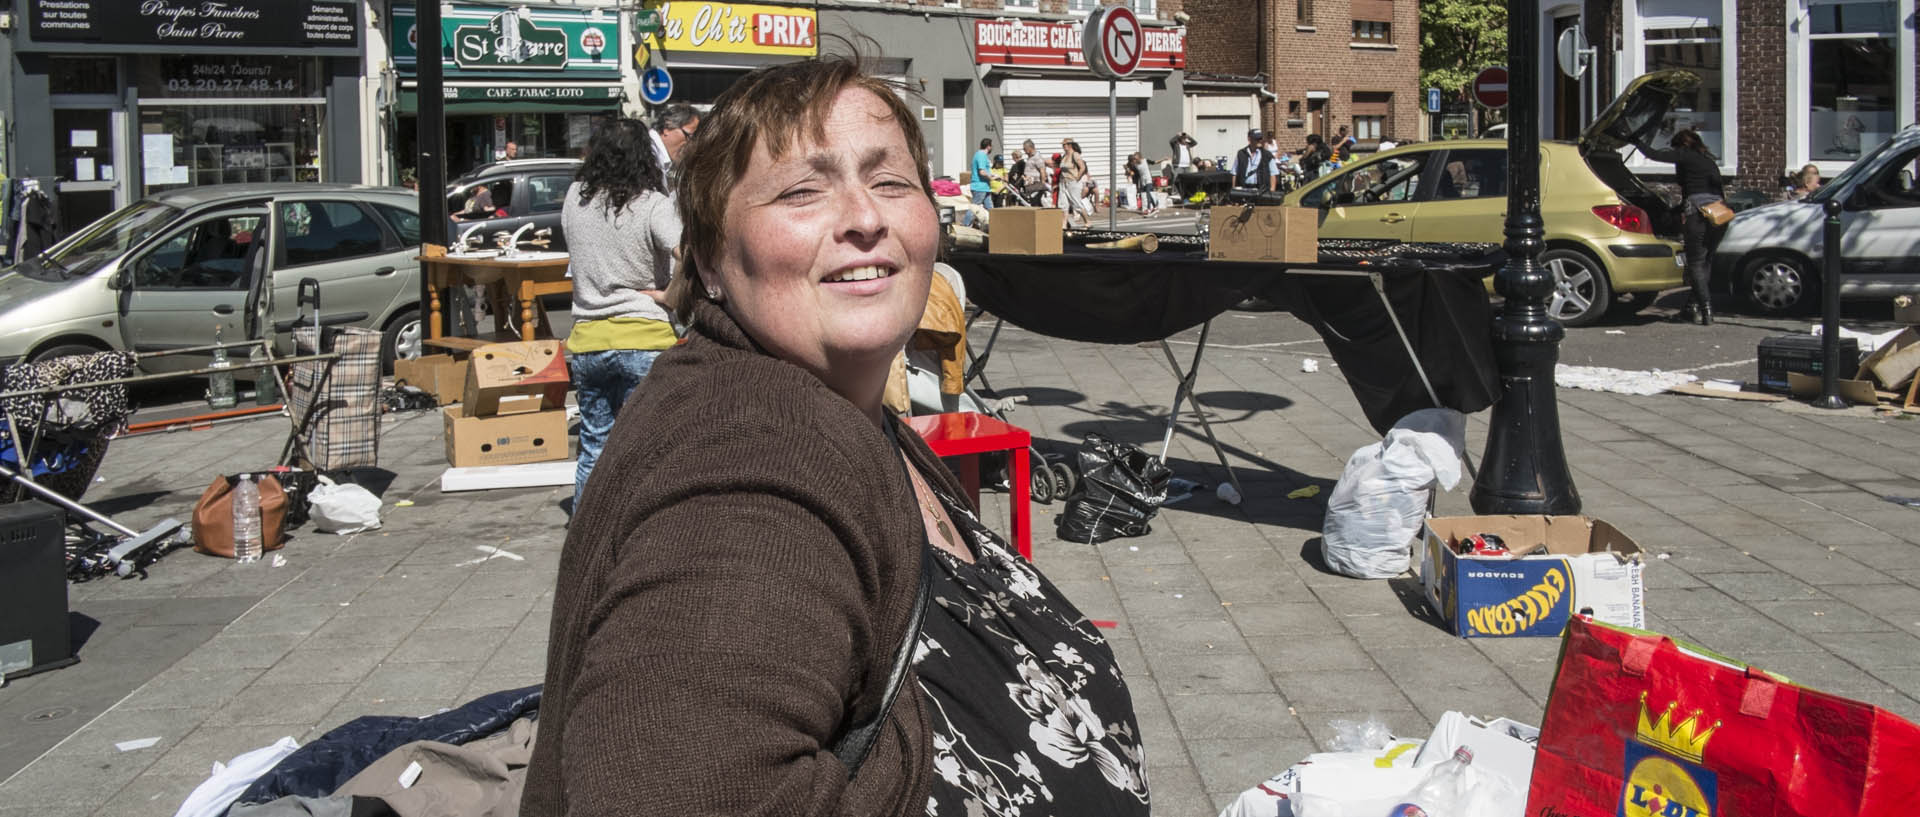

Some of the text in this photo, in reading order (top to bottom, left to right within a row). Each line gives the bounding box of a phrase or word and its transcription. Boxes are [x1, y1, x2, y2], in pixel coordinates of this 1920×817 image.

[40, 0, 90, 10] Prestations
[140, 0, 260, 21] Pompes Funèbres
[43, 11, 88, 19] sur toutes
[41, 21, 91, 29] communes
[156, 21, 246, 39] Saint Pierre
[690, 4, 748, 47] Ch'ti
[758, 14, 813, 46] PRIX
[978, 24, 1049, 49] BOUCHERIE
[1144, 31, 1184, 53] PIERRE
[461, 35, 489, 61] St
[168, 79, 294, 91] 03.20.27.48.14
[486, 88, 584, 98] CAFE TABAC LOTO
[1467, 571, 1525, 580] ECUADOR
[1631, 587, 1642, 629] BANANAS
